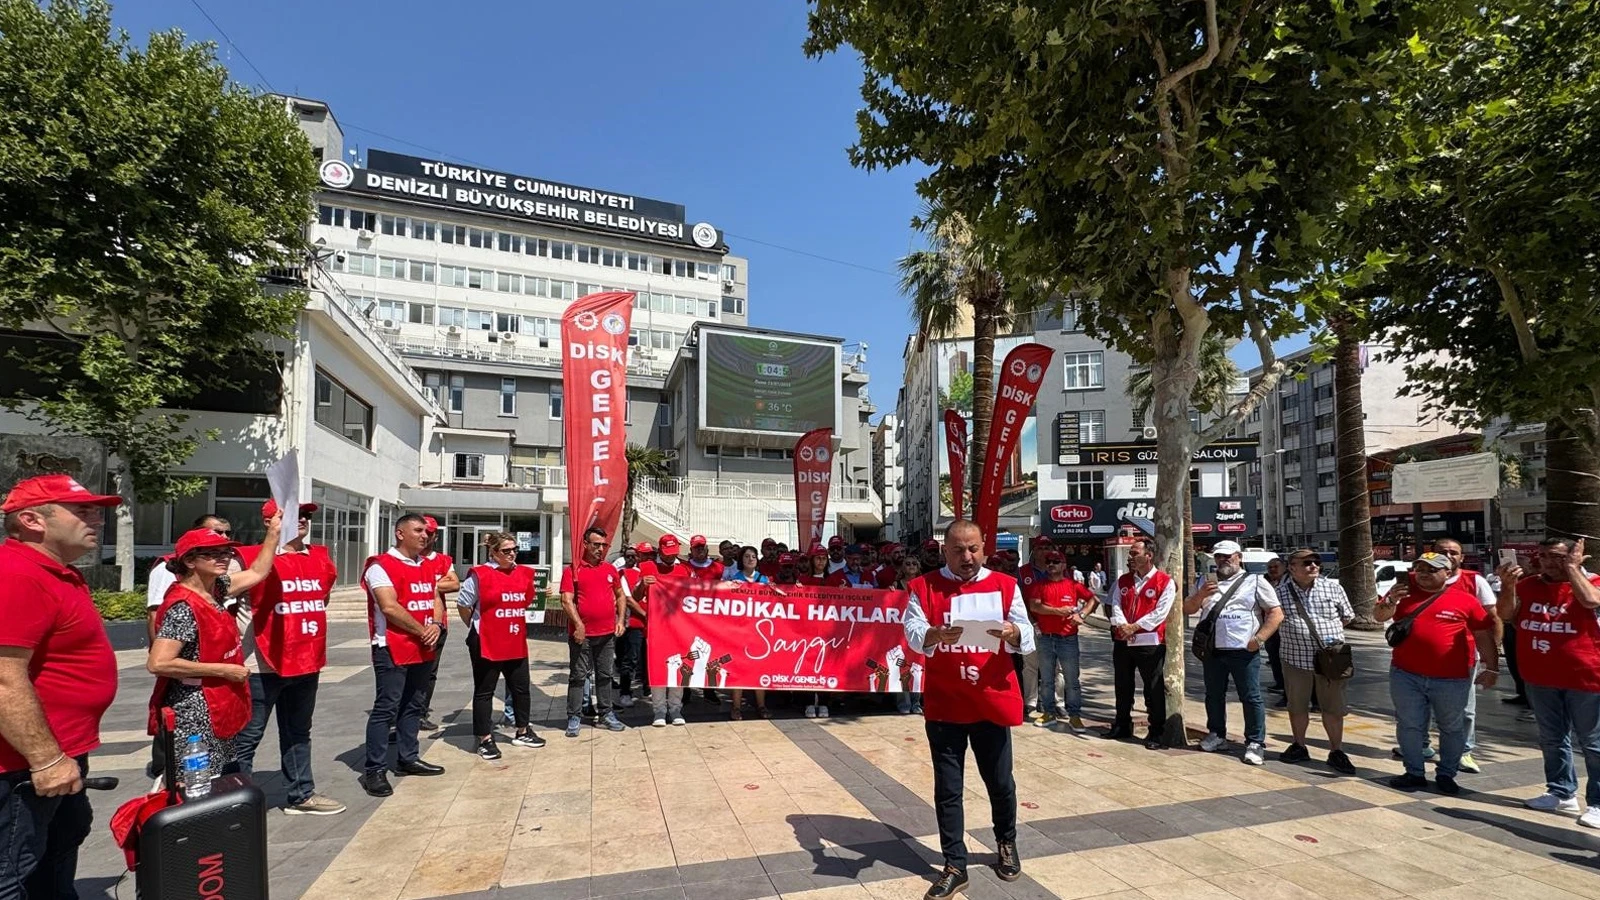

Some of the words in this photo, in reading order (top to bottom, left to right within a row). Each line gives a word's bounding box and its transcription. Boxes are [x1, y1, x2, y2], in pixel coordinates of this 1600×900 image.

[421, 161, 507, 188] TÜRKİYE
[514, 178, 634, 210] CUMHURİYETİ
[367, 173, 447, 199] DENİZLİ
[456, 188, 579, 221] BÜYÜKŞEHİR
[584, 210, 683, 238] BELEDİYESİ
[570, 341, 624, 366] DİSK
[1002, 385, 1034, 406] DİSK
[768, 402, 780, 411] 36
[590, 369, 612, 486] GENEL
[1091, 452, 1130, 462] IRIS
[1137, 451, 1158, 460] GÜZ
[1193, 449, 1238, 459] SALONU
[798, 469, 831, 483] DİSK
[810, 491, 823, 546] GEN
[1056, 508, 1088, 519] Torku
[281, 577, 322, 592] DİSK
[501, 591, 526, 602] DİSK
[495, 608, 526, 618] GENE
[682, 597, 800, 620] SENDİKAL
[1529, 602, 1567, 617] DİSK
[301, 618, 319, 636] İŞ
[509, 622, 520, 635] İŞ
[1520, 619, 1578, 634] GENEL
[744, 618, 855, 674] Saygı!
[1532, 636, 1551, 654] İŞ
[960, 661, 980, 685] İŞ
